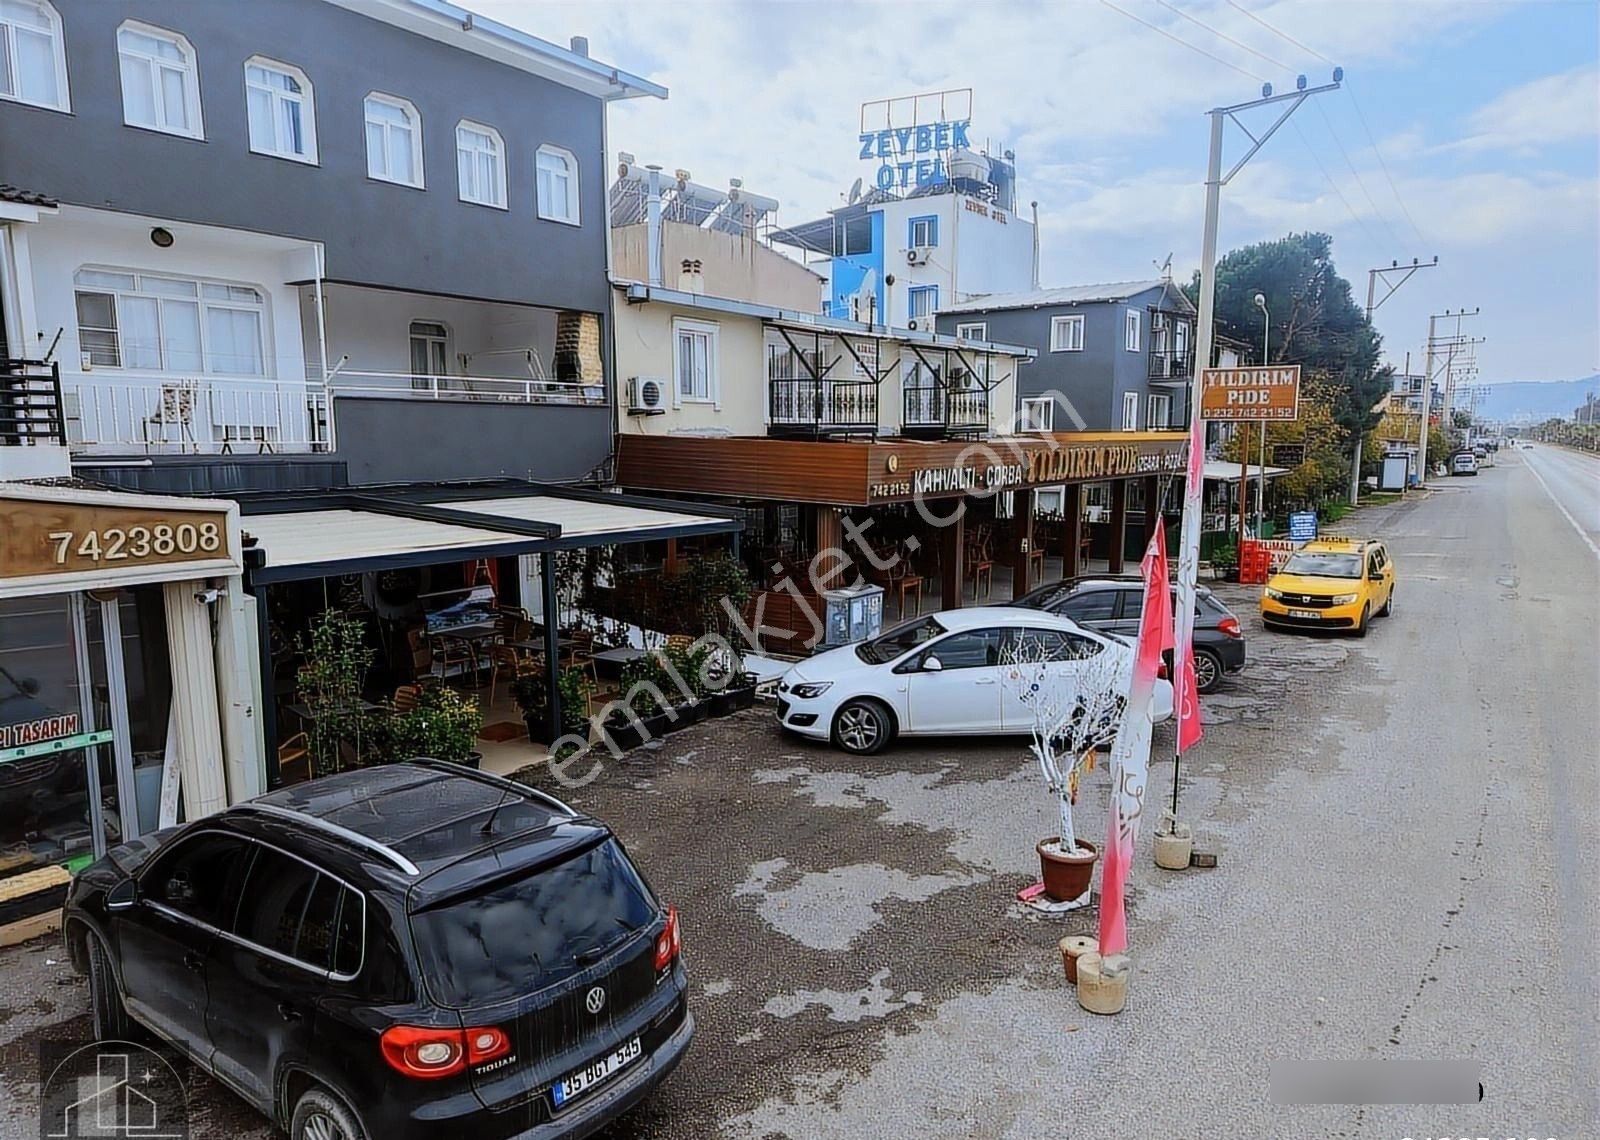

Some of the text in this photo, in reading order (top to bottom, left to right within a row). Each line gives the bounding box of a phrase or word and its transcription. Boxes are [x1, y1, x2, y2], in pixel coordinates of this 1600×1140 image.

[859, 120, 971, 160] ZEYBEK
[877, 158, 948, 190] OTEL
[1207, 370, 1294, 386] YILDIRIM
[913, 465, 1022, 493] KAHVALTI ÇORBA
[1024, 447, 1105, 482] YILDIRIM
[49, 522, 220, 564] 7423808
[13, 713, 78, 746] TASARIM
[563, 1076, 582, 1096] 35
[616, 1038, 640, 1064] 545
